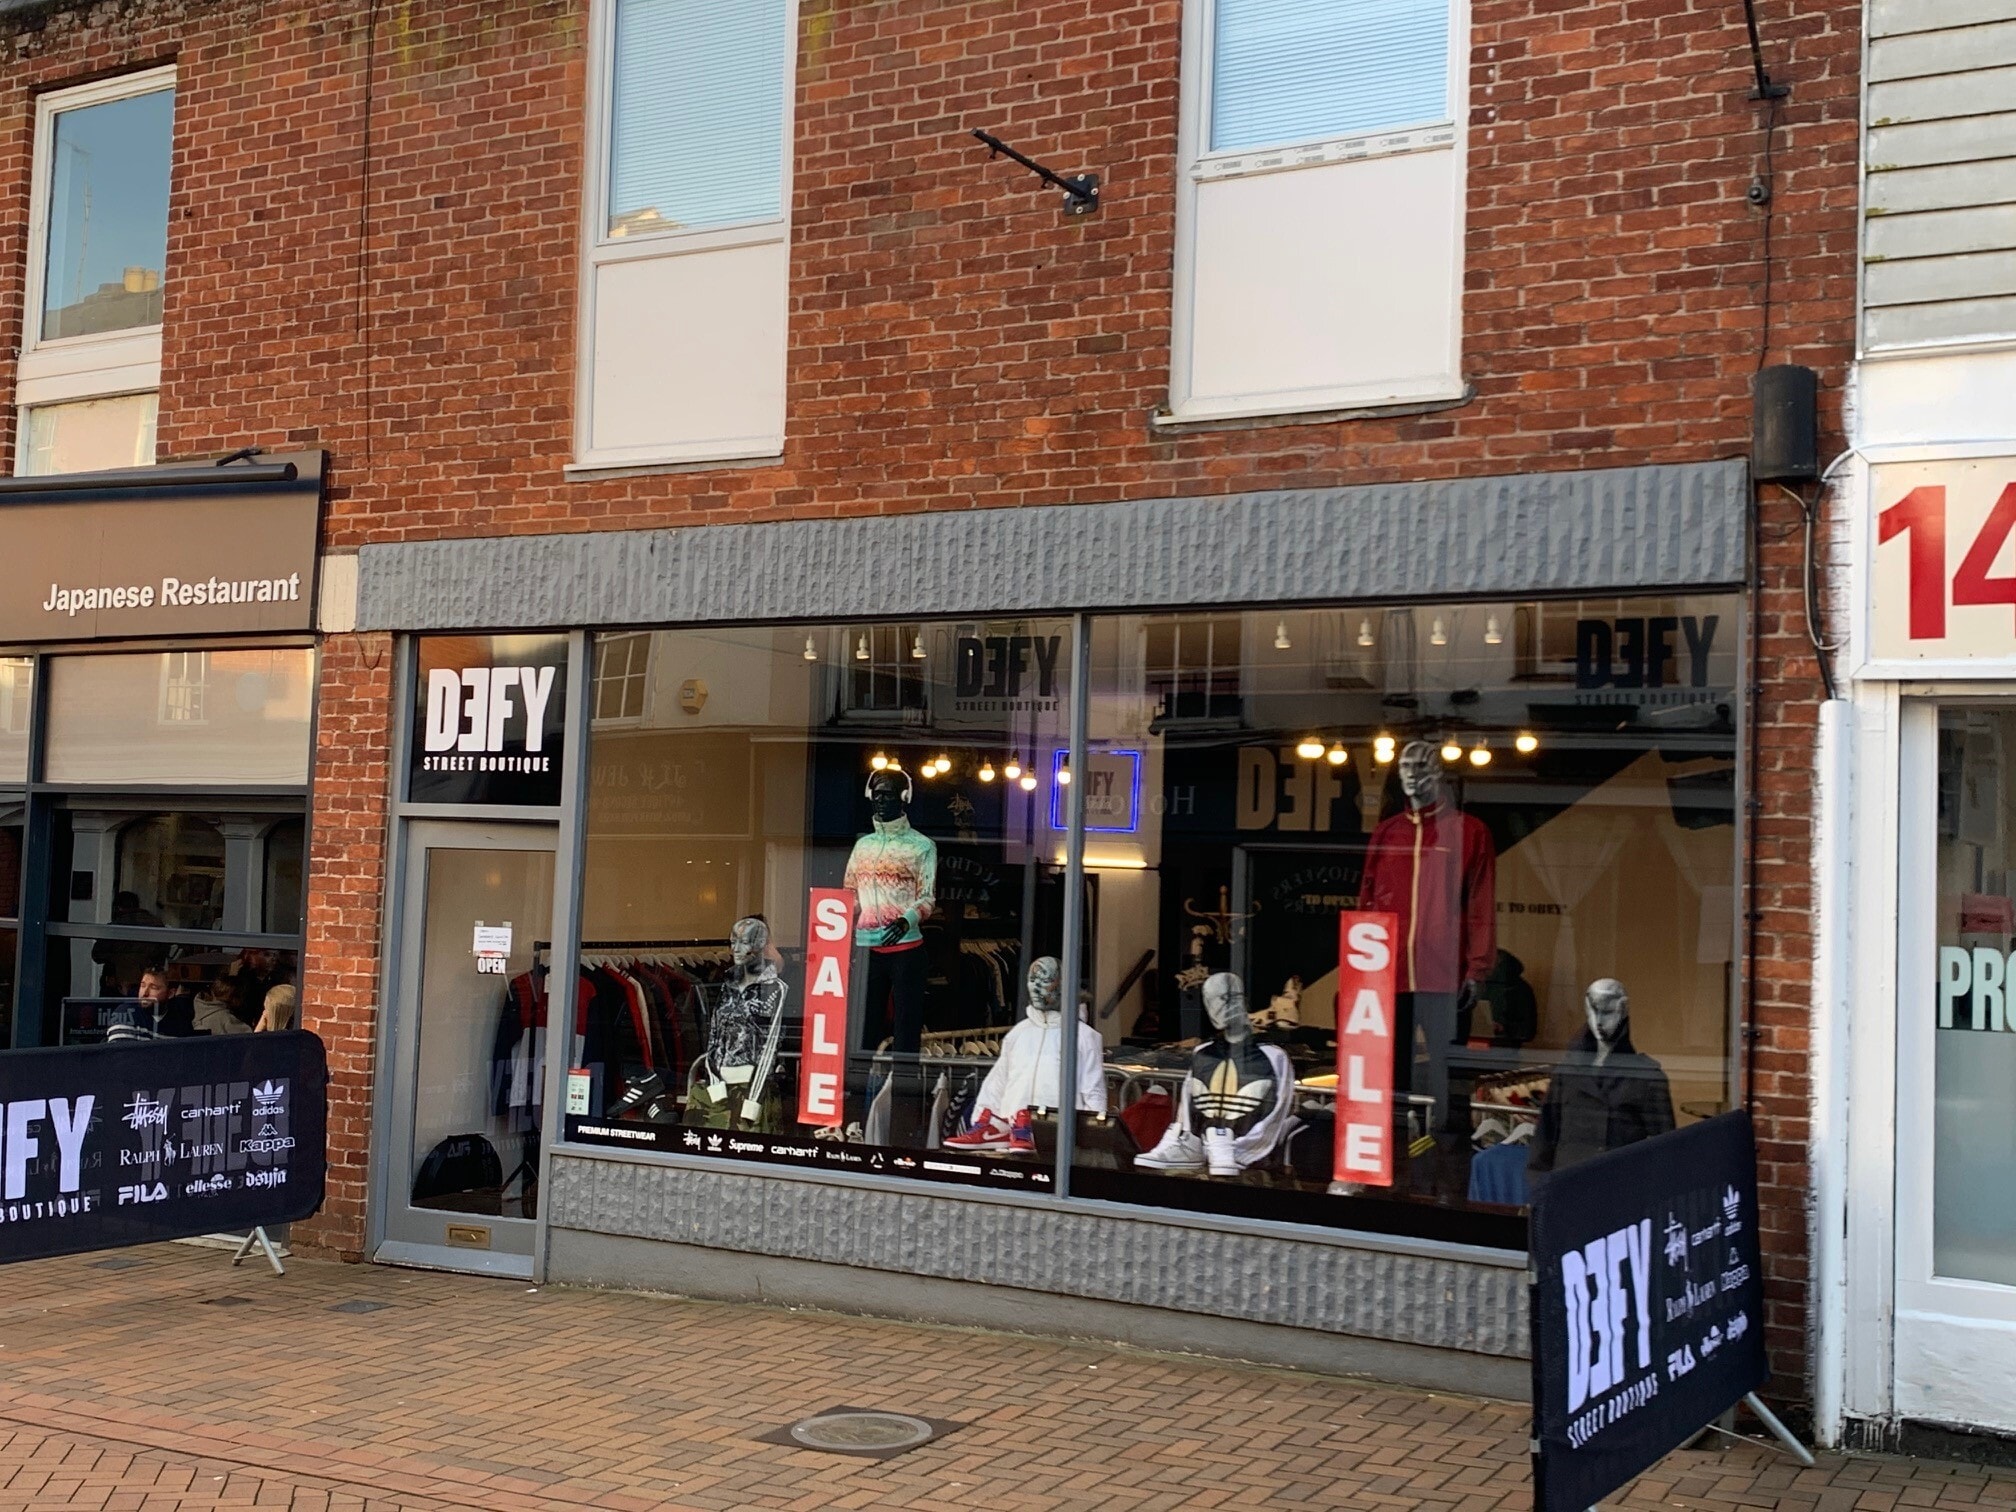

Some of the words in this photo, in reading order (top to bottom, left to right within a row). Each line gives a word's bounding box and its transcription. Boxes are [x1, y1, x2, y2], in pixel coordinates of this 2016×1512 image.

[43, 583, 154, 616] Japanese
[161, 572, 300, 607] Restaurant
[955, 701, 996, 712] STREET
[1001, 700, 1059, 713] BOUTIQUE
[423, 756, 474, 771] STREET
[479, 756, 550, 774] BOUTIQUE
[477, 957, 506, 974] OPEN
[807, 898, 848, 1116] SALE
[1344, 922, 1390, 1173] SALE
[252, 1105, 285, 1116] adidas
[0, 1094, 95, 1200] FY
[239, 1137, 295, 1154] Kappa
[577, 1125, 609, 1137] PREMIUM
[610, 1128, 656, 1141] STREETWEAR
[729, 1138, 764, 1153] Supreme
[118, 1182, 168, 1206] FILA
[185, 1175, 232, 1195] ellesse
[1567, 1403, 1605, 1449] STREET
